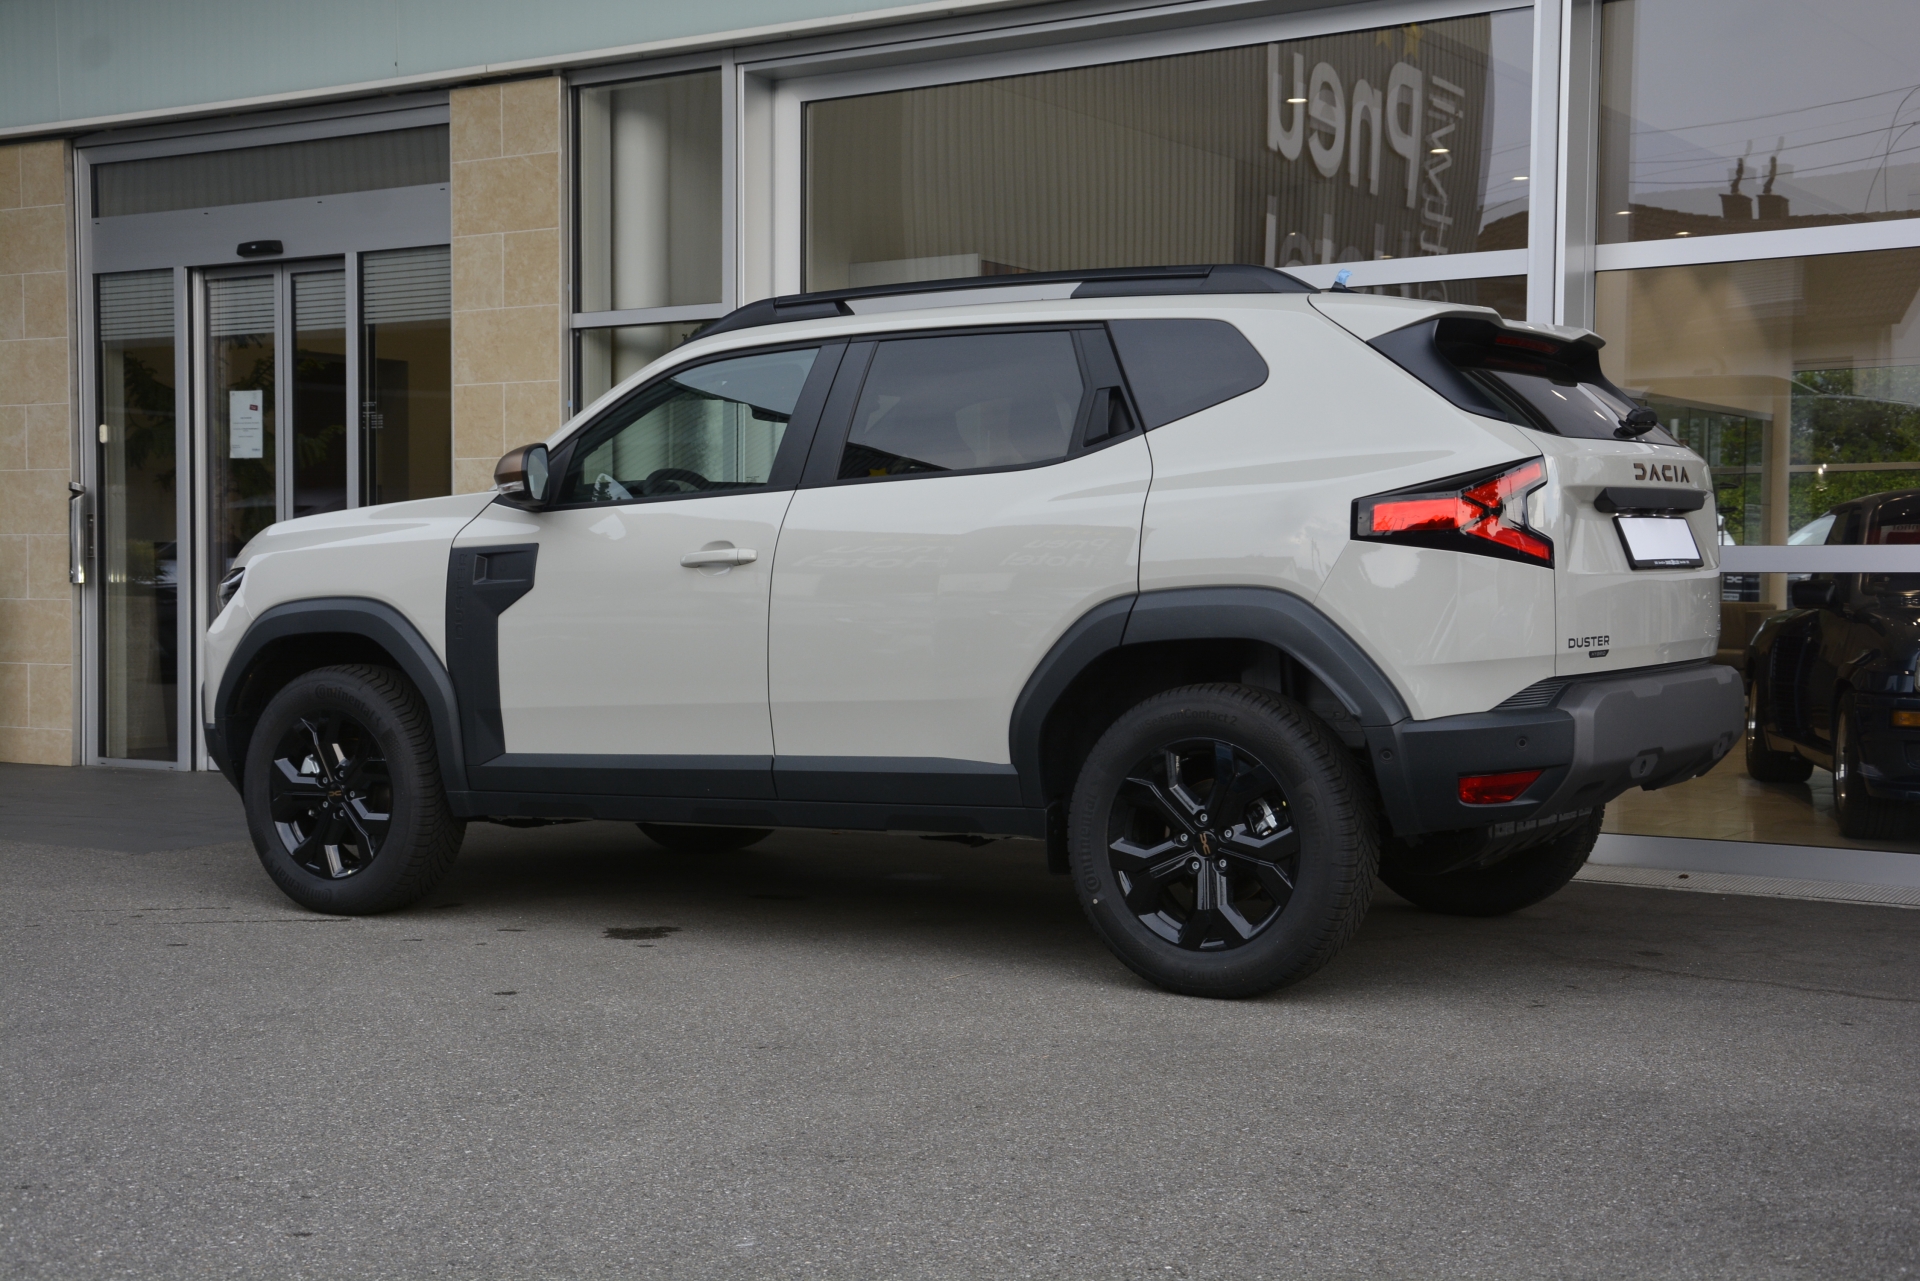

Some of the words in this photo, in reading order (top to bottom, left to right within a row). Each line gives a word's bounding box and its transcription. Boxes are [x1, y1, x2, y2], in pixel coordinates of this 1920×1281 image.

[1633, 462, 1690, 483] DACIA
[453, 552, 469, 641] DUSTER
[1568, 635, 1610, 649] DUSTER
[315, 684, 376, 721] Continental
[1229, 715, 1238, 726] 2
[1078, 792, 1102, 895] Continental
